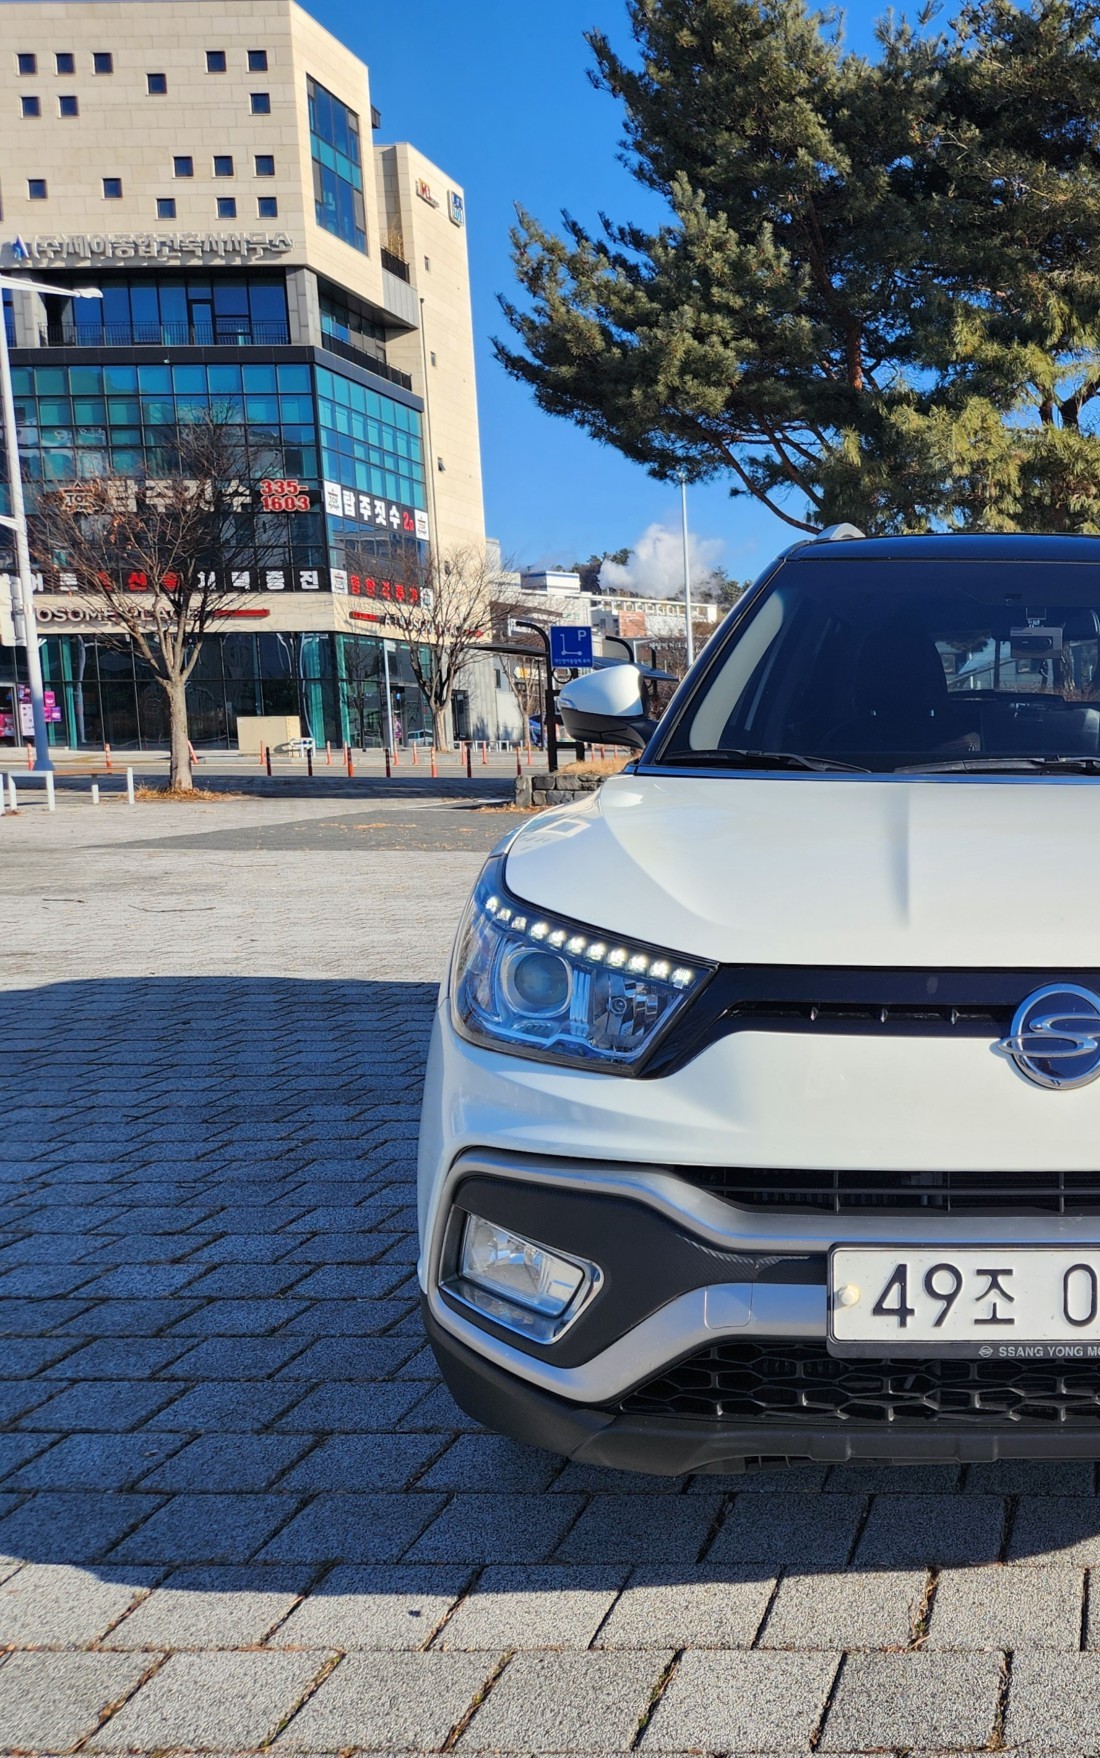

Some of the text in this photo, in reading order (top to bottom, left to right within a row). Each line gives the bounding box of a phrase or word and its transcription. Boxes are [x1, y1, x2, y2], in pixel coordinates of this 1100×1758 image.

[260, 478, 309, 496] 335-
[261, 495, 310, 512] 1603
[342, 489, 401, 530] 탑주짓수
[577, 630, 587, 642] P
[872, 1262, 1015, 1328] 49조
[998, 1346, 1045, 1357] SSANG
[1047, 1346, 1084, 1357] YONG
